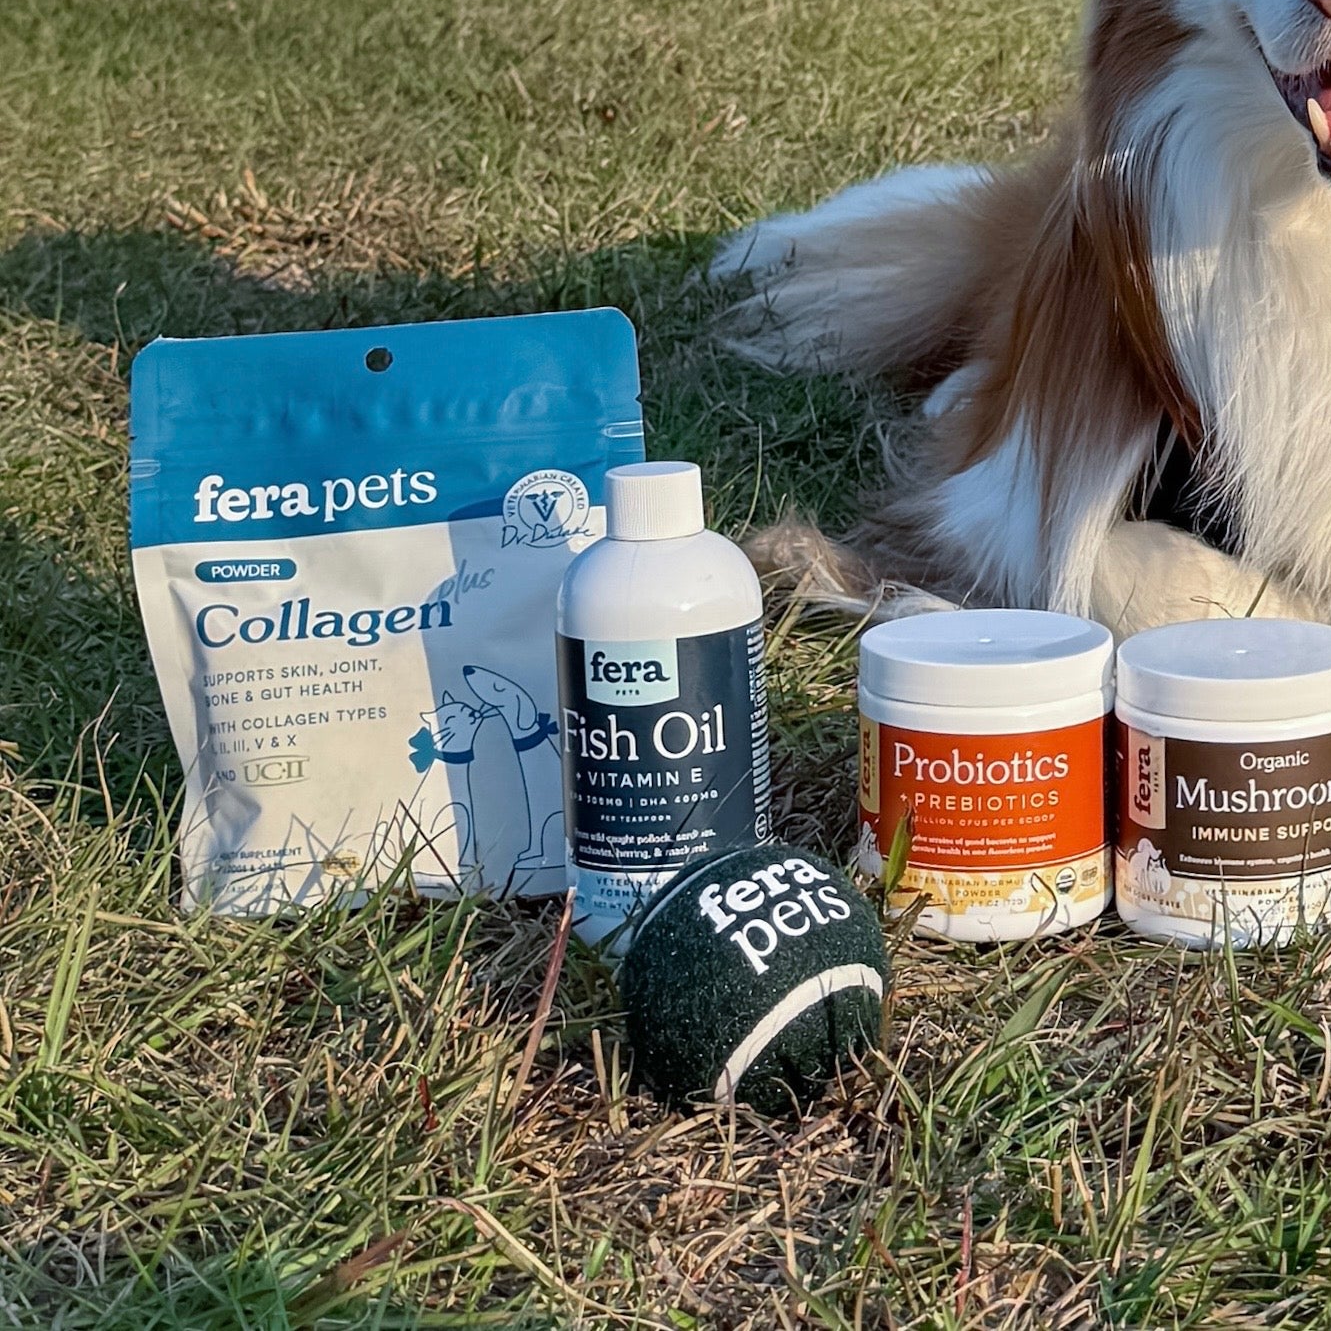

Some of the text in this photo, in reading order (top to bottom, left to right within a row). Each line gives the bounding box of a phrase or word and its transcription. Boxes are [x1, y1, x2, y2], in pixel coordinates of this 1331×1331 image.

[193, 468, 438, 523] fera pets
[210, 563, 281, 579] POWDER
[196, 558, 496, 649] Collagen plus
[203, 658, 383, 688] SUPPORTS SKIN, JOINT,
[590, 651, 671, 683] fera
[245, 690, 254, 703] &
[260, 686, 293, 701] GUT
[299, 680, 363, 697] HEALTH
[208, 706, 388, 735] WITH COLLAGEN TYPES
[563, 703, 727, 761] Fish Oil
[255, 737, 265, 750] V
[271, 736, 280, 748] &
[287, 734, 297, 747] X
[893, 742, 1069, 785] Probiotics
[1239, 750, 1310, 773] Organic
[587, 770, 680, 788] VITAMIN
[690, 767, 704, 783] E
[1134, 744, 1151, 816] fera
[914, 789, 1060, 812] PREBIOTICS
[1191, 825, 1270, 843] IMMUNE
[698, 858, 831, 934] fera
[955, 889, 1001, 897] POWDER
[729, 885, 851, 976] pets
